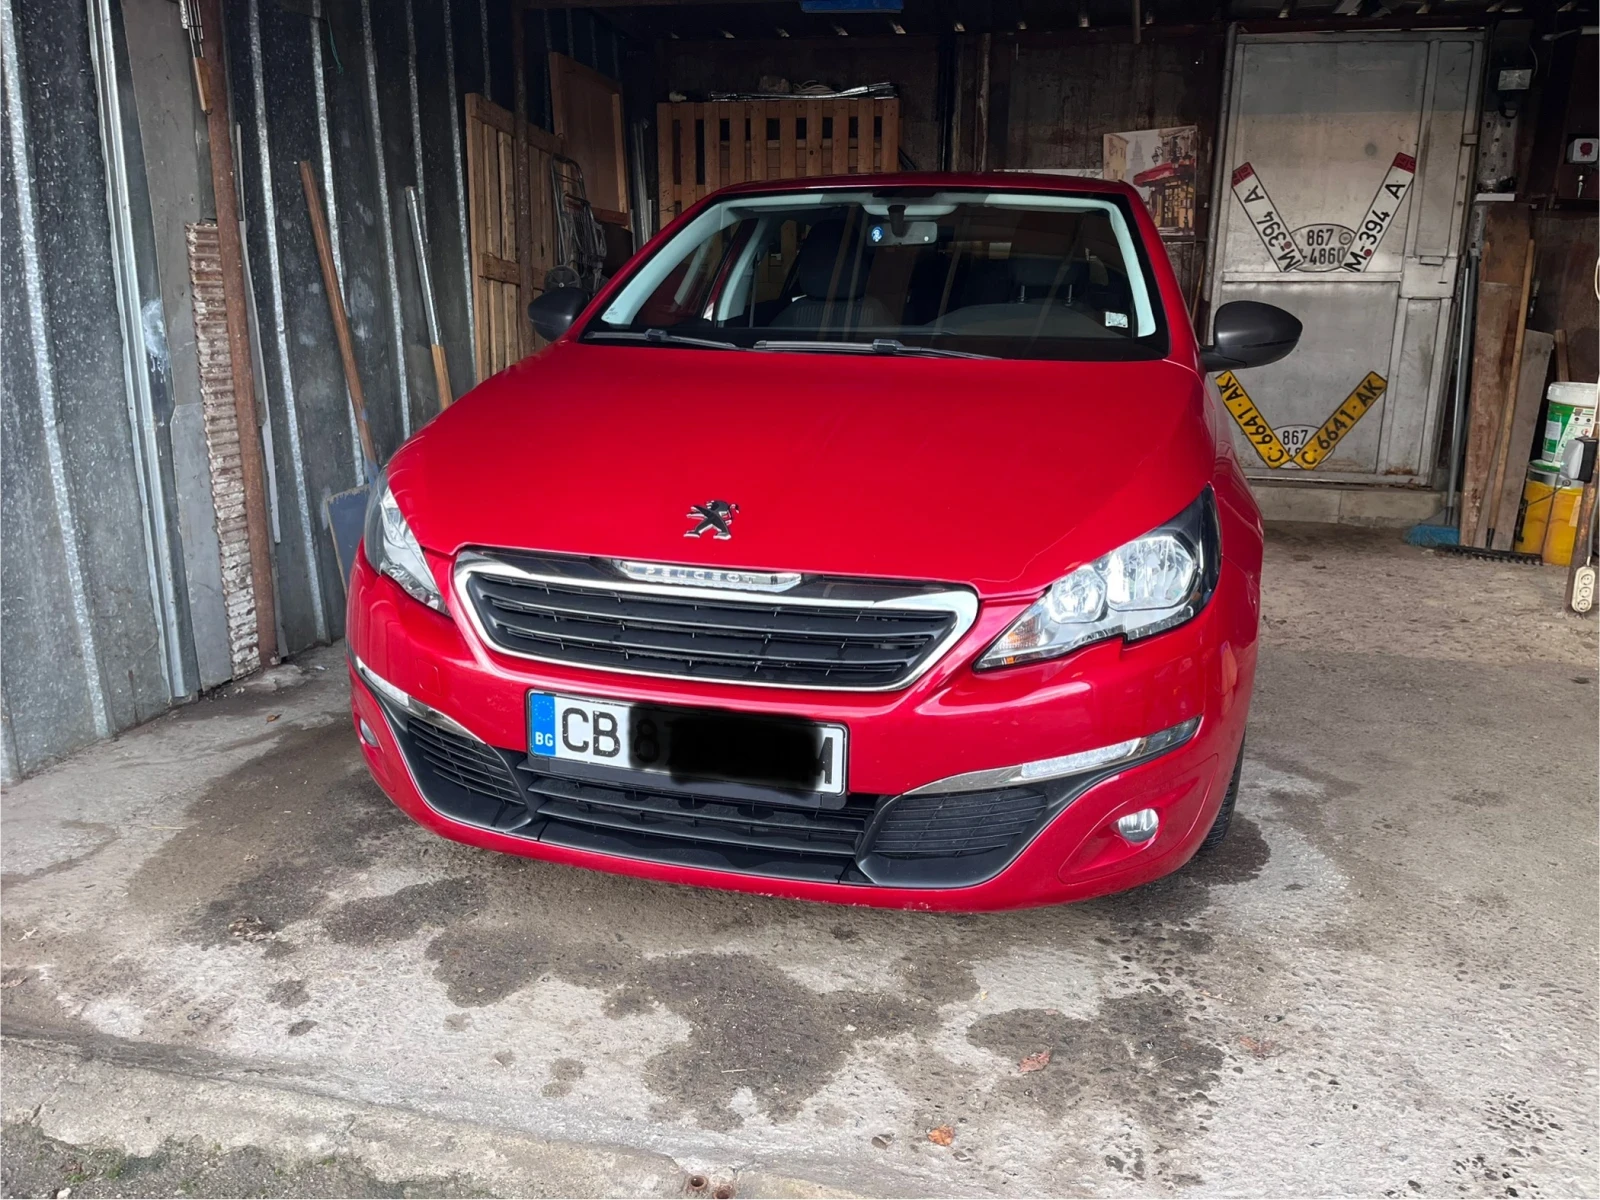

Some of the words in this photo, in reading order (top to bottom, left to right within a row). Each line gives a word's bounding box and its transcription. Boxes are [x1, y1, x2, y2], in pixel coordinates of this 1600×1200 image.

[1244, 185, 1264, 203] A
[1385, 183, 1406, 200] A
[1307, 228, 1334, 246] 867
[1283, 430, 1308, 445] 867
[535, 731, 554, 747] BG
